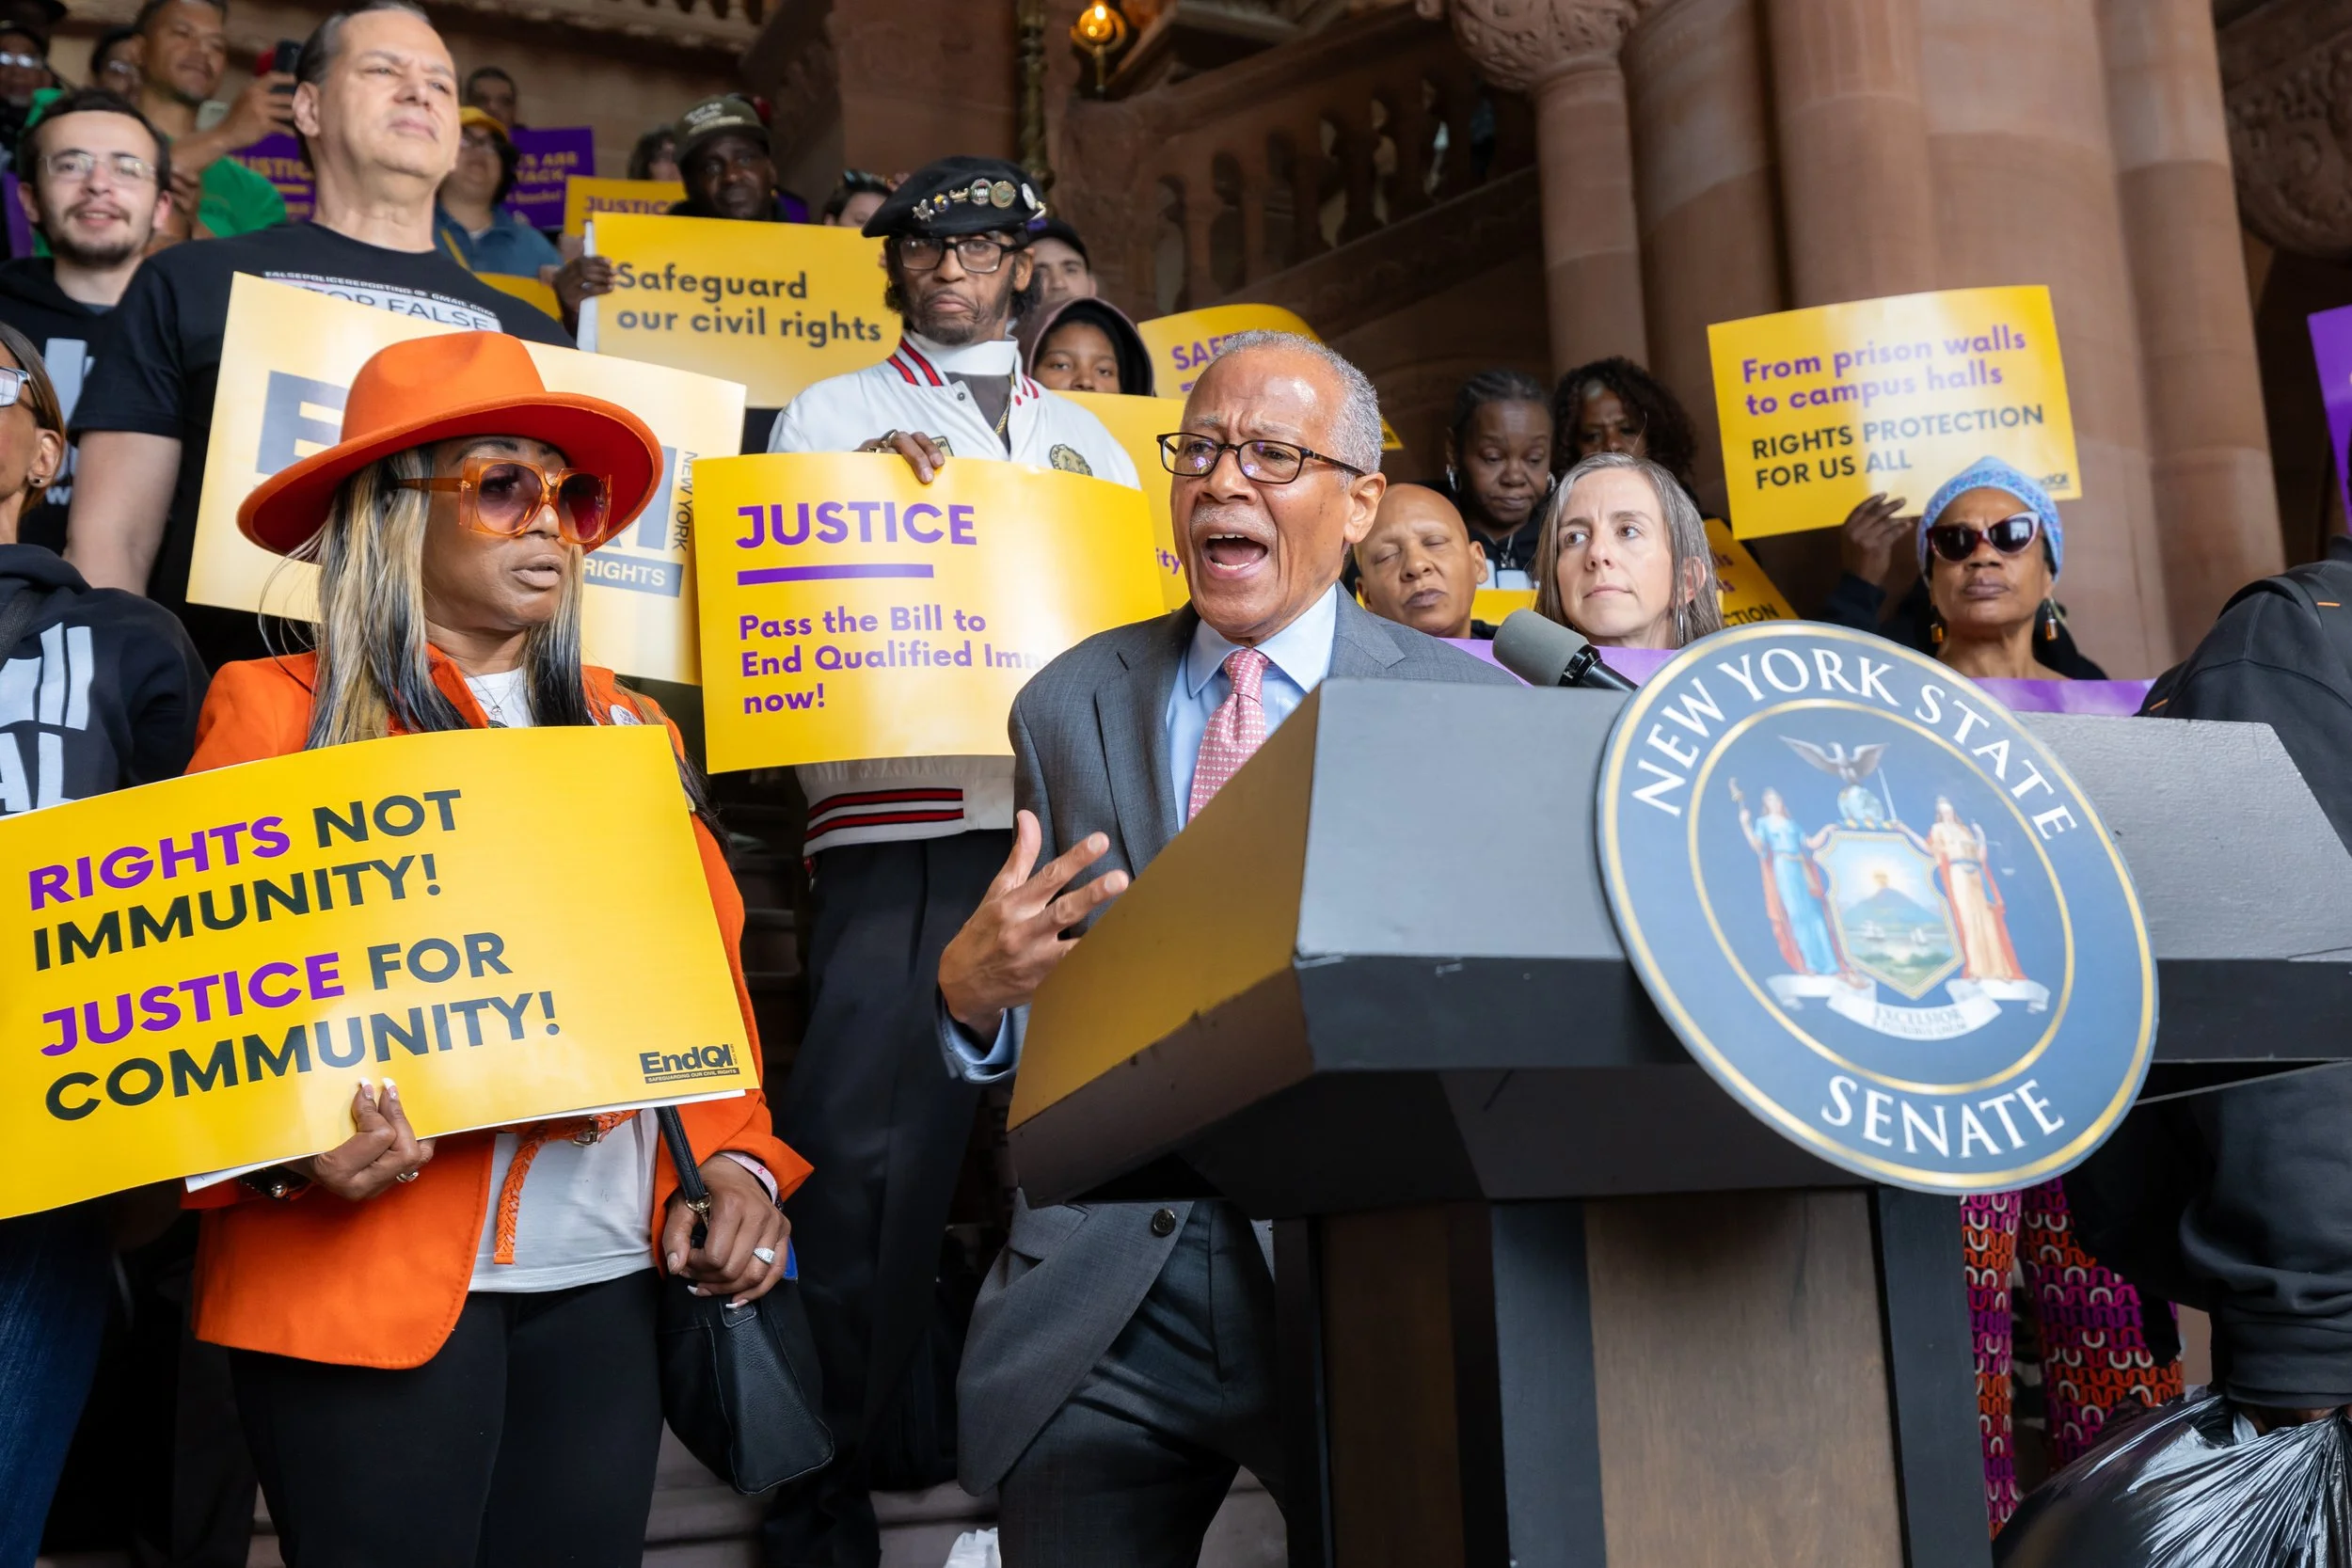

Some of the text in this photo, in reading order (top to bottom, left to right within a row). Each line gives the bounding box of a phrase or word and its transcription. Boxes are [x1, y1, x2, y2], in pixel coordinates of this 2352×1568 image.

[616, 261, 807, 303] Safeguard
[617, 307, 882, 348] our civil rights
[1742, 324, 2026, 384] From prison walls
[1746, 359, 2004, 417] to campus halls
[1752, 404, 2044, 460] RIGHTS PROTECTION
[1756, 449, 1914, 490] FOR US ALL
[672, 450, 699, 552] NEW YORK
[736, 500, 977, 548] JUSTICE
[582, 557, 666, 587] RIGHTS
[739, 604, 987, 641] Pass the Bill to
[740, 644, 802, 677] End
[815, 640, 973, 671] Qualified
[743, 683, 826, 715] now!
[1632, 647, 2078, 840] NEW YORK STATE
[28, 788, 462, 911] RIGHTS NOT
[33, 852, 442, 972] IMMUNITY!
[40, 931, 514, 1058] JUSTICE FOR
[45, 990, 561, 1122] COMMUNITY!
[647, 1073, 691, 1083] SAFEGUARDING
[1820, 1075, 2065, 1159] SENATE
